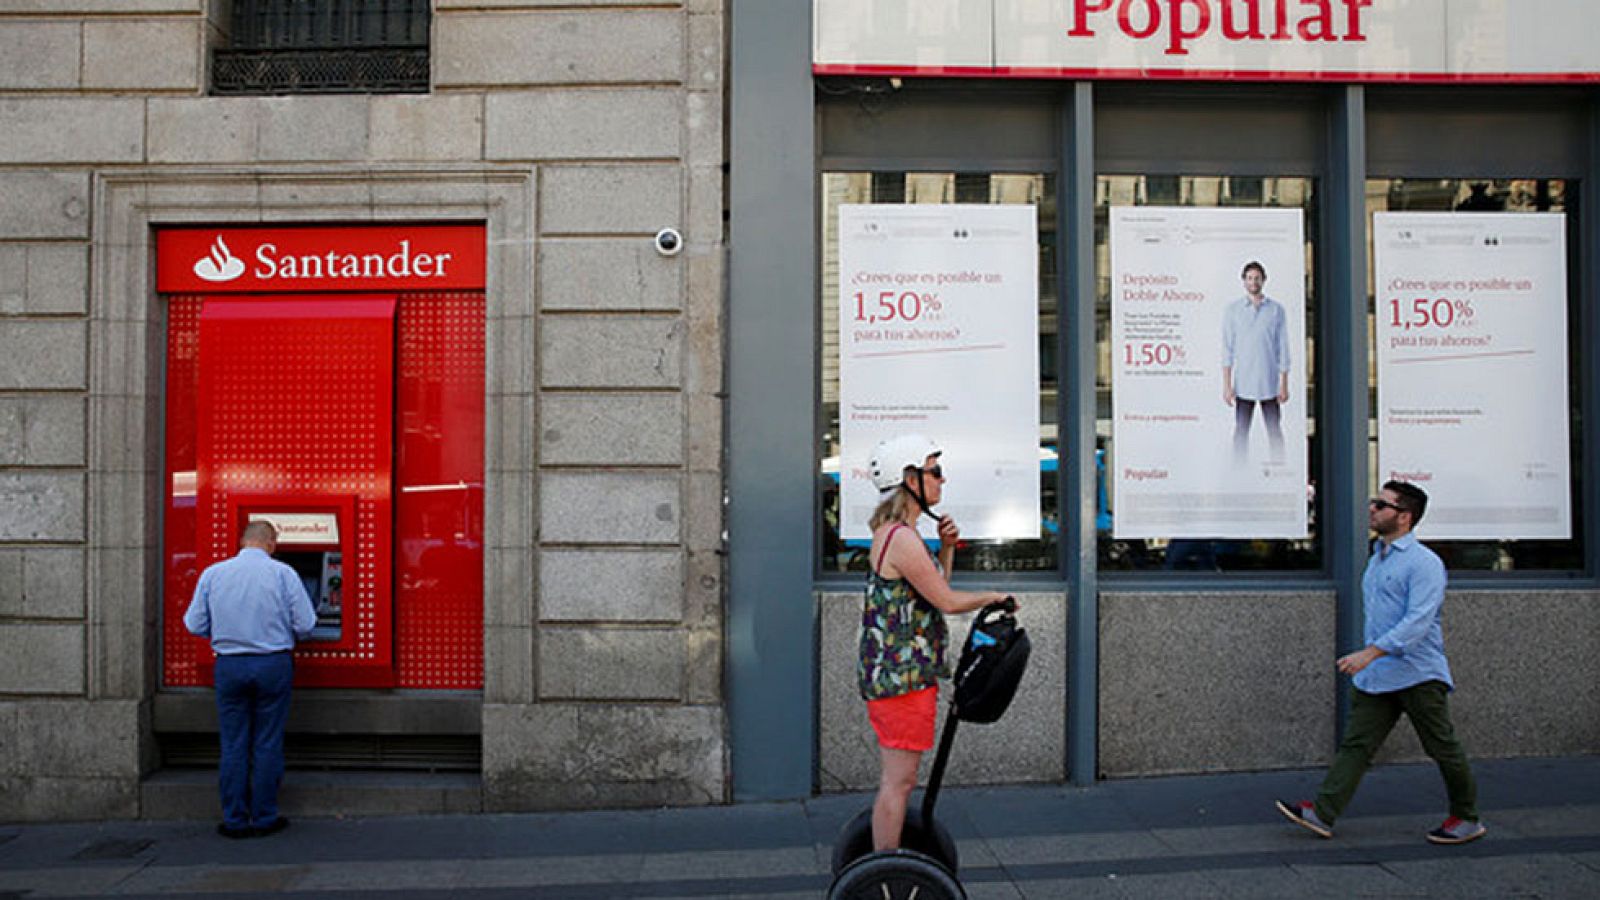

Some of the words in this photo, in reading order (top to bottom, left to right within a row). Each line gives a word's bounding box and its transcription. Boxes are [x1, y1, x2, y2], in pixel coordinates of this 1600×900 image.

[1068, 0, 1372, 55] Popular
[255, 240, 452, 279] Santander
[851, 270, 893, 286] ¿Crees
[895, 273, 919, 285] que
[921, 273, 935, 283] es
[937, 270, 982, 285] posible
[985, 273, 1002, 283] un
[1388, 278, 1426, 292] ¿Crees
[1429, 280, 1452, 293] que
[1454, 280, 1466, 290] es
[1468, 277, 1512, 293] posible
[1514, 280, 1532, 290] un
[1123, 289, 1158, 301] Doble
[853, 331, 881, 343] para
[885, 328, 904, 340] tus
[1390, 336, 1417, 348] para
[1419, 335, 1438, 347] tus
[1125, 469, 1168, 481] Popular
